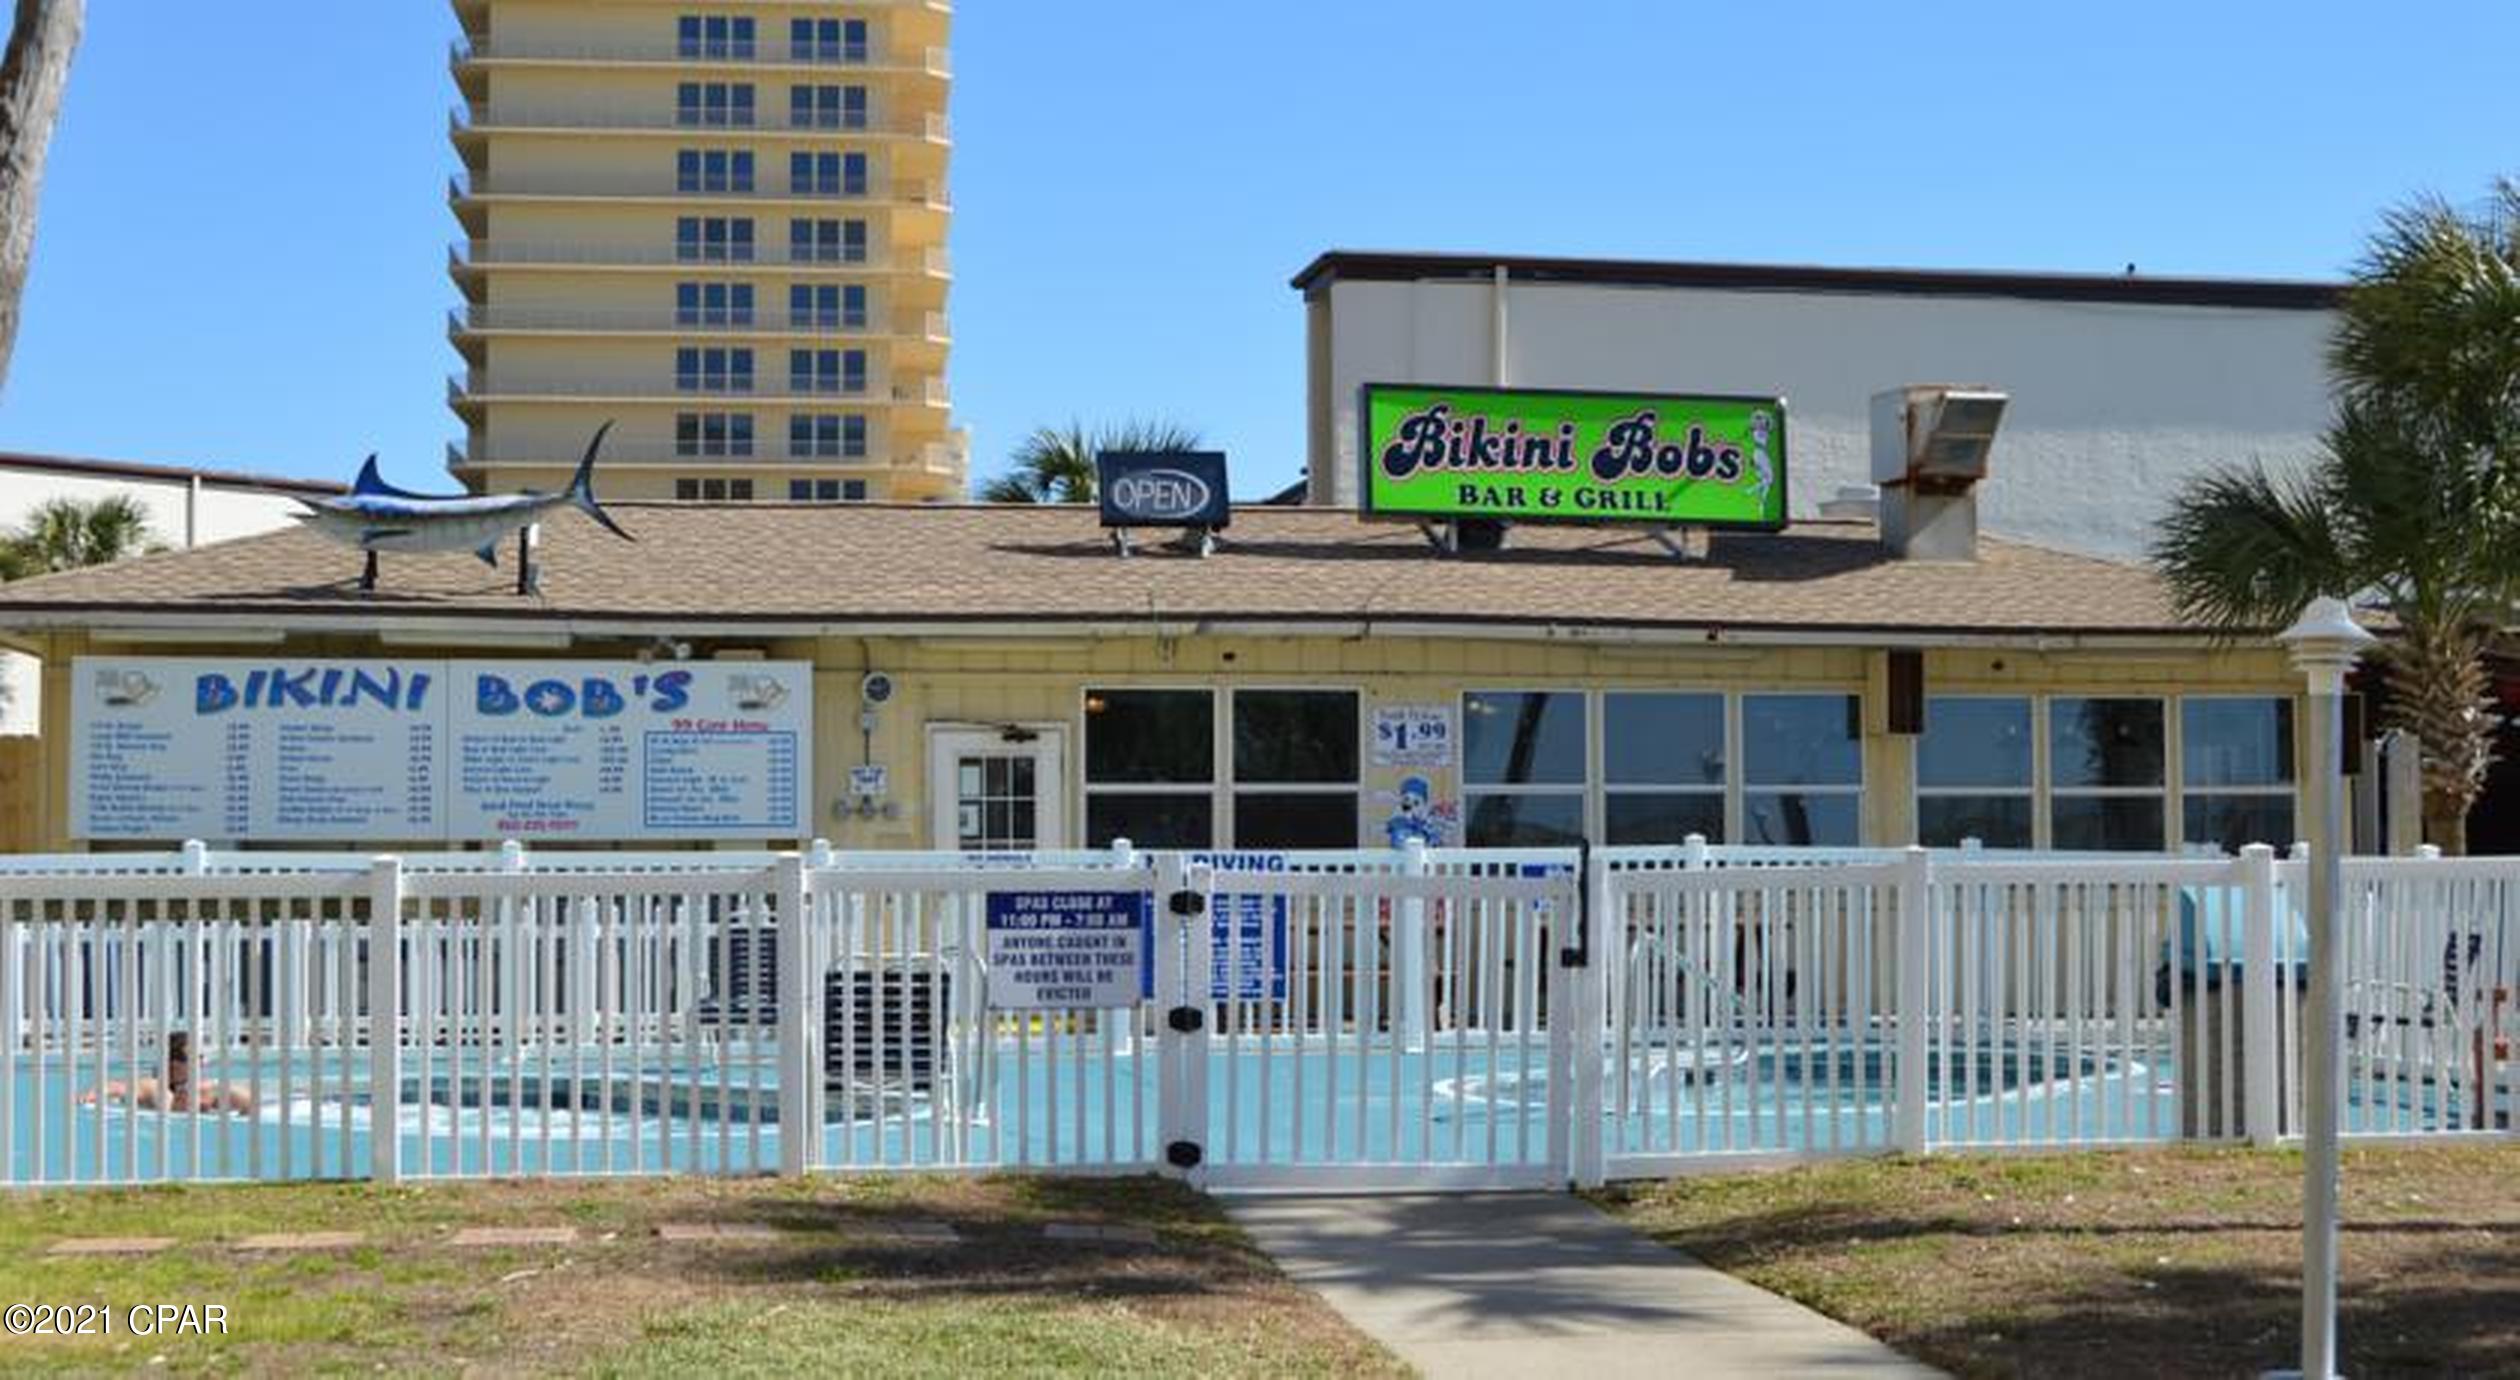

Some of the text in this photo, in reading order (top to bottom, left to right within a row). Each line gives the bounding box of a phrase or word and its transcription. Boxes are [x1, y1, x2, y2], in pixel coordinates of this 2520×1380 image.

[1383, 404, 1743, 483] Bikini Bobs
[1113, 477, 1193, 511] OPEN
[1458, 484, 1671, 513] BAR & GRILL
[196, 666, 693, 719] BIKINI BOB'S
[1378, 721, 1446, 750] $1.99
